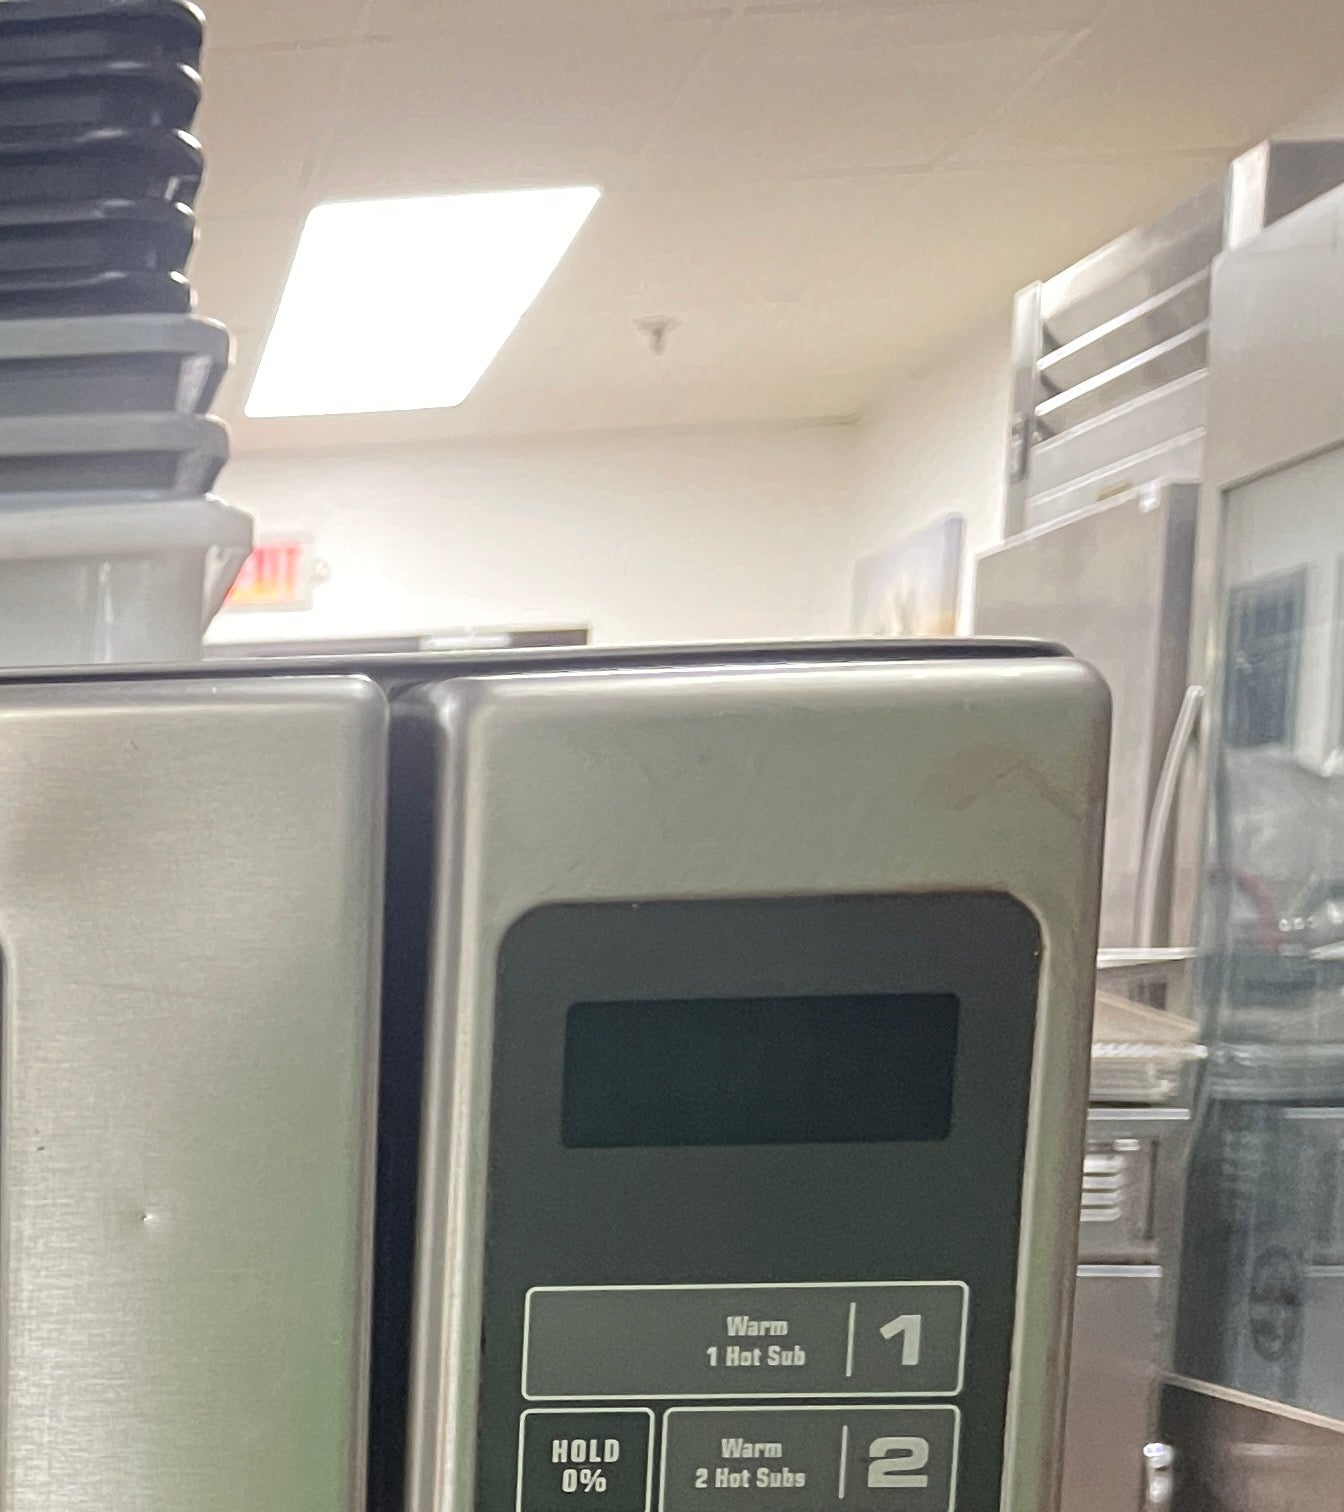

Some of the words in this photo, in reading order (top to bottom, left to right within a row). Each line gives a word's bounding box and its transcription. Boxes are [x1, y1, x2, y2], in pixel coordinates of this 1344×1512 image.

[726, 1315, 788, 1337] Warm
[879, 1314, 922, 1366] 1
[706, 1346, 718, 1367] 1
[725, 1345, 762, 1367] Hot
[767, 1344, 806, 1366] Sub
[551, 1438, 620, 1463] HOLD
[721, 1437, 783, 1459] Warm
[867, 1436, 930, 1488] 2
[562, 1468, 607, 1493] 0%
[695, 1467, 709, 1489] 2
[714, 1467, 751, 1488] Hot
[755, 1467, 806, 1488] Subs
